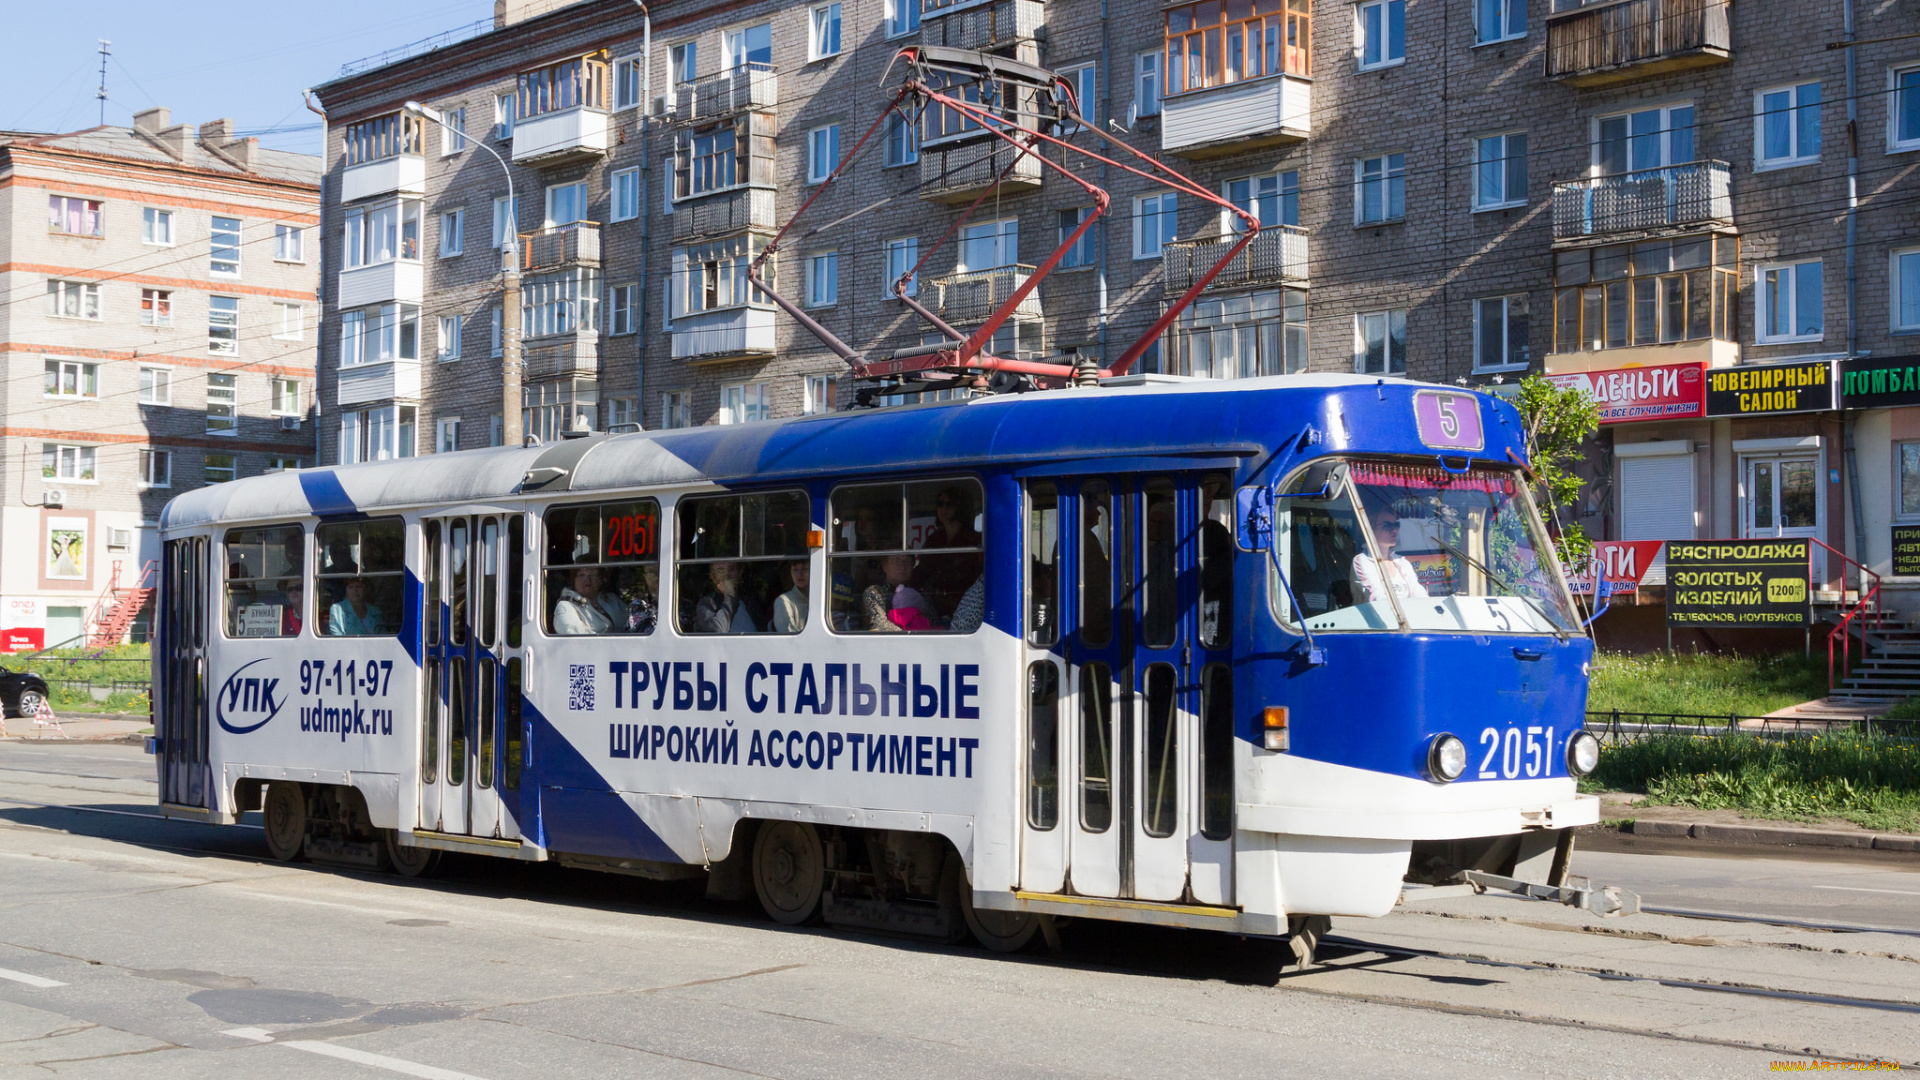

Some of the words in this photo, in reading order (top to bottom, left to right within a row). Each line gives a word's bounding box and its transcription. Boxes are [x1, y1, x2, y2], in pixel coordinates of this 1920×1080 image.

[1593, 368, 1679, 402] ДЕНЬГИ
[1713, 363, 1825, 392] ЮВЕЛИРНЫЙ
[1437, 395, 1459, 439] 5
[1611, 407, 1627, 418] ВСЕ
[1665, 402, 1699, 414] ЖИЗНИ
[1740, 390, 1796, 412] САЛОН
[608, 513, 654, 556] 2051
[1670, 544, 1806, 560] РАСПРОДАЖА
[1898, 555, 1920, 564] НЕД
[1675, 571, 1763, 586] ЗОЛОТЫХ
[1770, 584, 1795, 596] 1200
[1675, 587, 1762, 605] ИЗДЕЛИЙ
[1484, 598, 1511, 631] 5
[1672, 612, 1737, 623] ТЕЛЕФОНОВ,
[1740, 613, 1803, 623] НОУТБУКОВ
[300, 659, 393, 697] 97-11-97
[609, 661, 727, 712] ТРУБЫ
[745, 662, 980, 719] СТАЛЬНЫЕ
[228, 678, 280, 714] УПК
[300, 699, 393, 743] udmpk.ru
[609, 720, 738, 765] ШИРОКИЙ
[747, 729, 980, 778] АССОРТИМЕНТ
[1478, 726, 1554, 779] 2051
